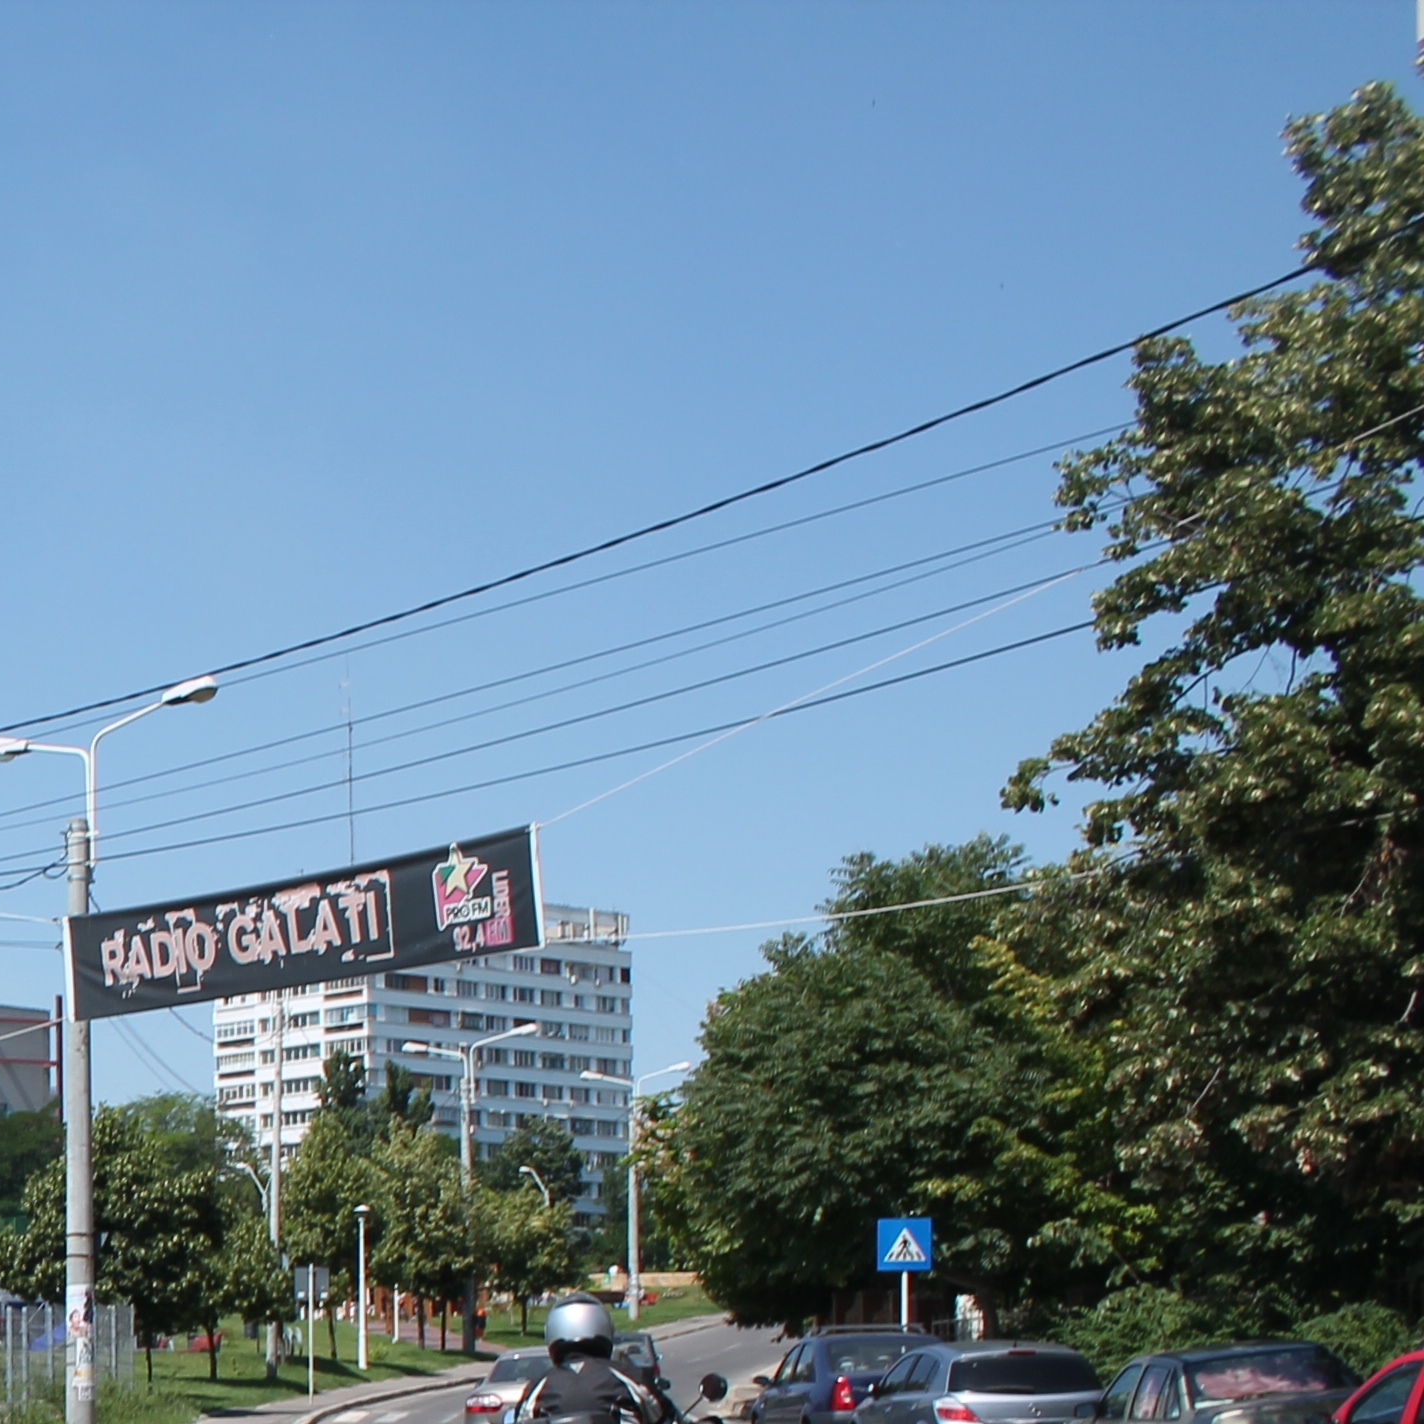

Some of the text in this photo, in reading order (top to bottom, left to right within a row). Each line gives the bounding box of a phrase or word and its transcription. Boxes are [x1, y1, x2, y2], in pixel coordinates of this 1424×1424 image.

[445, 899, 489, 920] PRO FM
[453, 922, 485, 953] 92,4
[101, 921, 217, 987] RADIO
